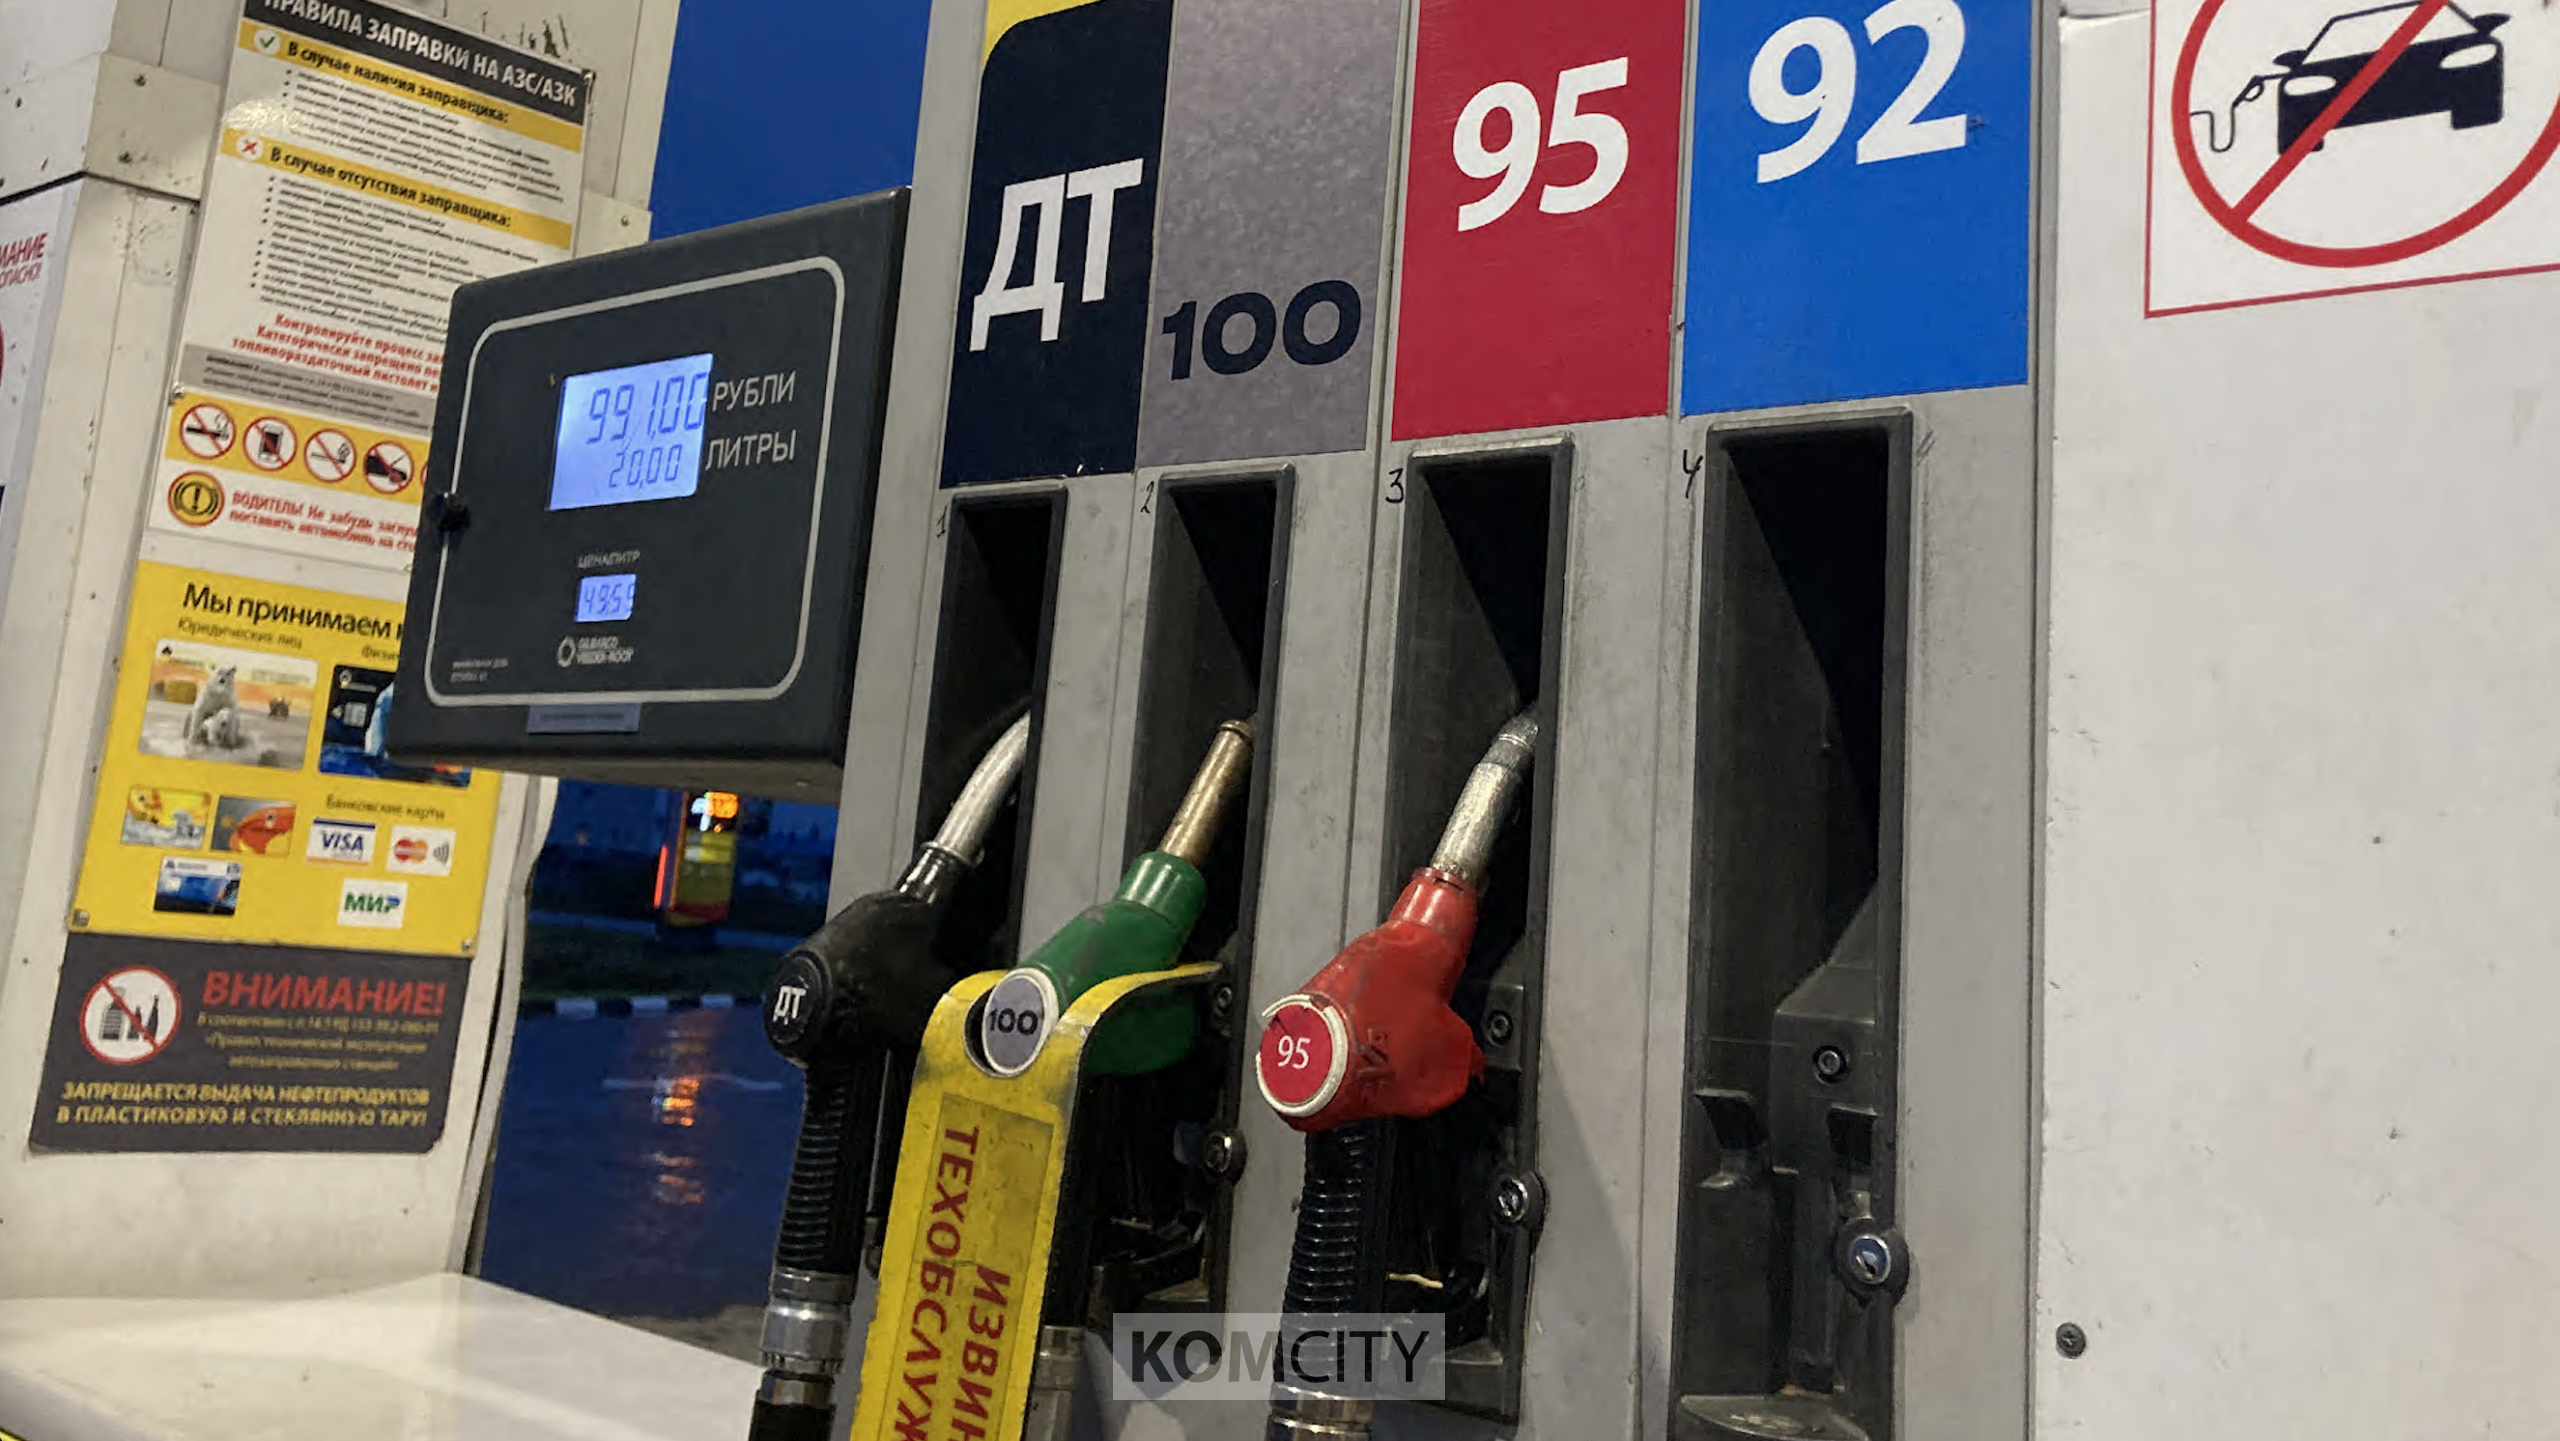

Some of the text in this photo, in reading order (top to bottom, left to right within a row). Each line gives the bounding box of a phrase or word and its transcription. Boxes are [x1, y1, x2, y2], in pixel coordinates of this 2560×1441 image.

[287, 41, 509, 124] В случае наличия заправщика:
[367, 18, 469, 69] ЗАПРАВКИ
[473, 56, 499, 81] НА
[502, 64, 577, 107] АЗС/АЗК
[1748, 0, 1968, 184] 92
[1452, 57, 1629, 232] 95
[270, 146, 511, 228] В случае отсутствия заправщика:
[969, 158, 1144, 352] ДТ
[256, 325, 350, 357] Категорически
[353, 350, 422, 374] запрещено
[275, 313, 372, 347] Контролируйте
[375, 339, 424, 359] процесс
[1162, 279, 1362, 381] 100
[232, 337, 371, 378] топливораздаточный
[373, 367, 428, 390] пистолет
[712, 371, 796, 412] РУБЛИ
[705, 429, 797, 471] ЛИТРЫ
[1385, 467, 1404, 503] 3
[1683, 449, 1703, 499] 4
[230, 509, 295, 530] поставить
[298, 522, 375, 547] автомобиль
[378, 534, 394, 549] на
[308, 504, 325, 521] Не
[330, 512, 373, 533] забудь
[178, 616, 303, 649] Юридических лиц
[182, 582, 233, 614] Мы
[237, 597, 392, 641] принимаем
[326, 794, 446, 822] Банковские карты
[322, 830, 364, 852] VISA
[344, 891, 401, 914] МИР
[202, 970, 447, 1016] ВНИМАНИЕ!
[772, 984, 807, 1026] ДТ
[985, 1006, 1039, 1036] 100
[1277, 1035, 1310, 1069] 95
[63, 1081, 431, 1106] ЗАПРЕЩАЕТСЯ ВЫДАЧА НЕФТЕПРОДУКТОВ
[56, 1104, 428, 1127] В ПЛАСТИКОВУЮ И СТЕКЛЯННУЮ ТАРУ!
